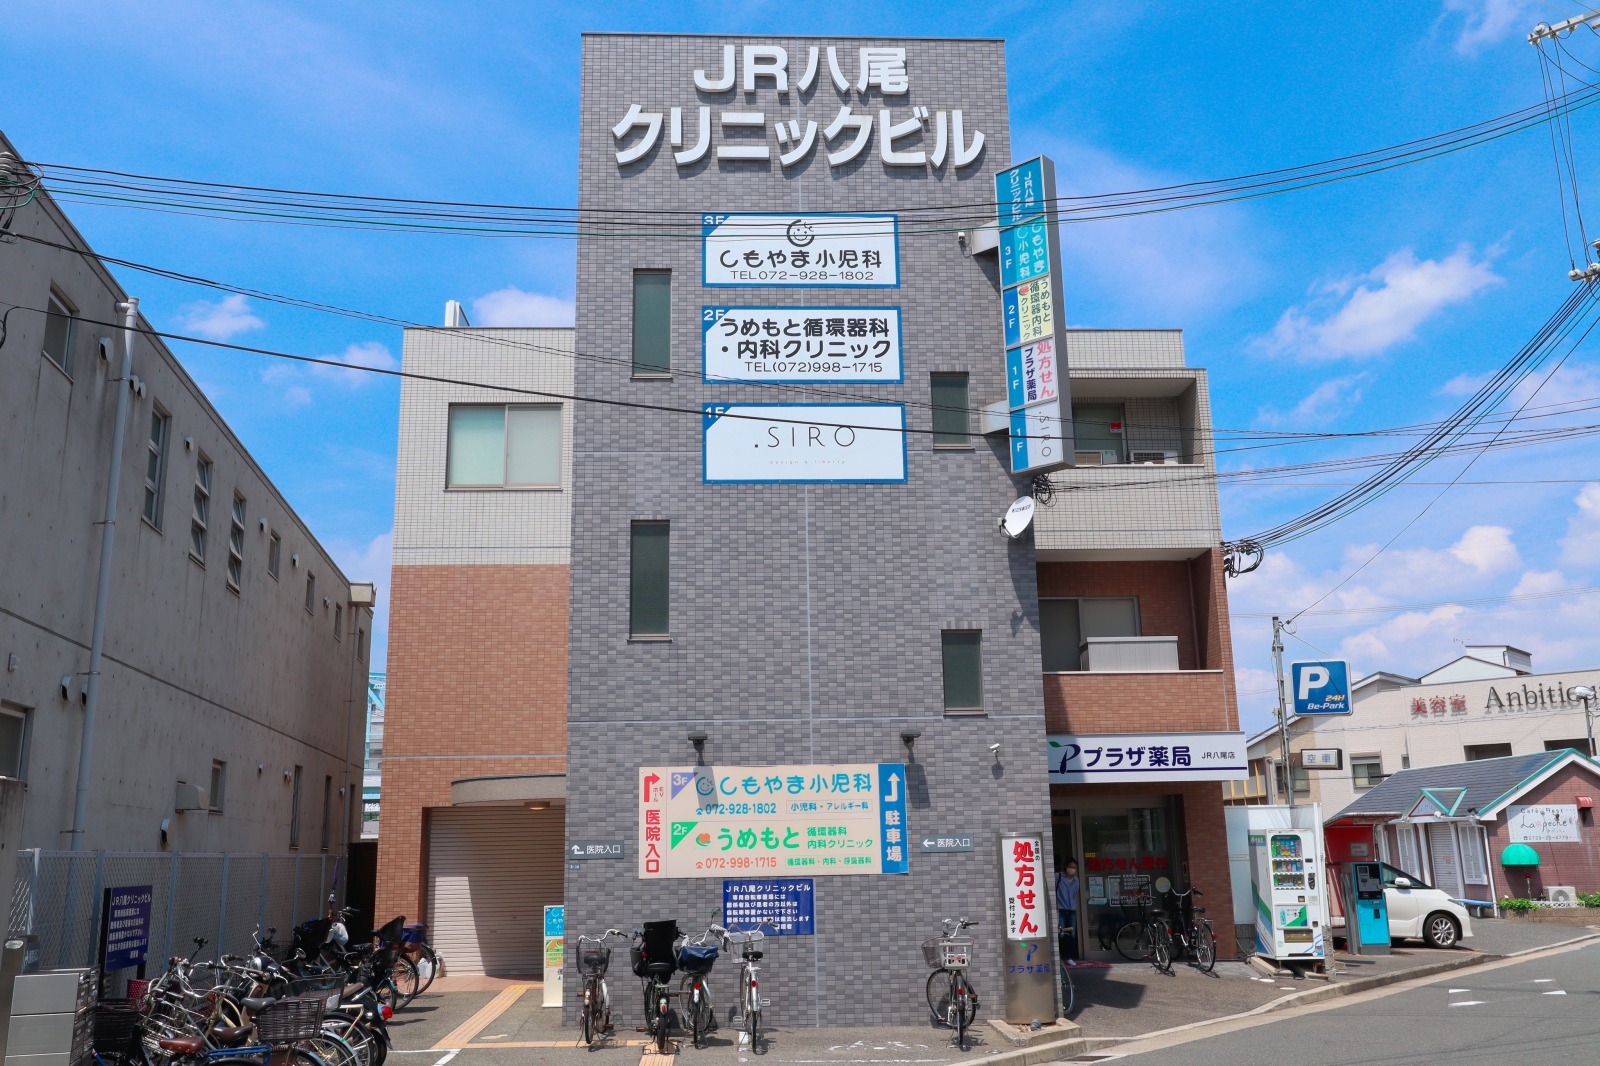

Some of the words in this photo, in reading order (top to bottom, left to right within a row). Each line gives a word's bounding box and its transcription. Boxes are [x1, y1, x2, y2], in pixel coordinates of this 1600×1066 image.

[694, 44, 909, 94] JR八尾
[611, 104, 985, 168] クリニックビル
[1024, 171, 1035, 208] JR八尾
[704, 215, 725, 225] 3F
[1031, 222, 1046, 273] しもやま
[720, 250, 882, 269] しもやま小児科
[1018, 239, 1031, 279] 小児科
[1030, 281, 1043, 337] 循環器内科
[1040, 279, 1051, 322] うめもと
[704, 310, 725, 321] 2F
[1020, 297, 1031, 340] クリニック
[720, 318, 889, 337] うめもと循環器科
[1024, 347, 1037, 401] プラザ薬局
[1037, 341, 1054, 399] 処方せん
[705, 407, 725, 419] 1F
[1298, 665, 1330, 700] P
[1325, 694, 1345, 702] 24H
[1410, 694, 1468, 716] 美容室
[1484, 681, 1600, 708] Anbitio
[1307, 702, 1345, 710] Be-Park
[1084, 745, 1192, 768] プラザ薬局
[1201, 751, 1236, 760] JR八尾店
[1307, 753, 1331, 764] 空車
[673, 774, 688, 786] 3F
[720, 773, 872, 795] しもやま小児科
[791, 802, 869, 811] 小児科・アレルギー科
[645, 809, 661, 873] 医院入口
[673, 824, 688, 836] 2F
[718, 826, 800, 850] うめもと
[807, 826, 847, 836] 循環器科
[885, 810, 902, 862] 駐車場
[586, 844, 621, 854] 医院入口
[807, 839, 873, 849] 内科クリニック
[937, 838, 970, 848] 医院入口
[726, 884, 811, 893] JR八尾クリニックビル
[1013, 841, 1038, 934] 処方せん
[1008, 897, 1016, 933] 受付けます
